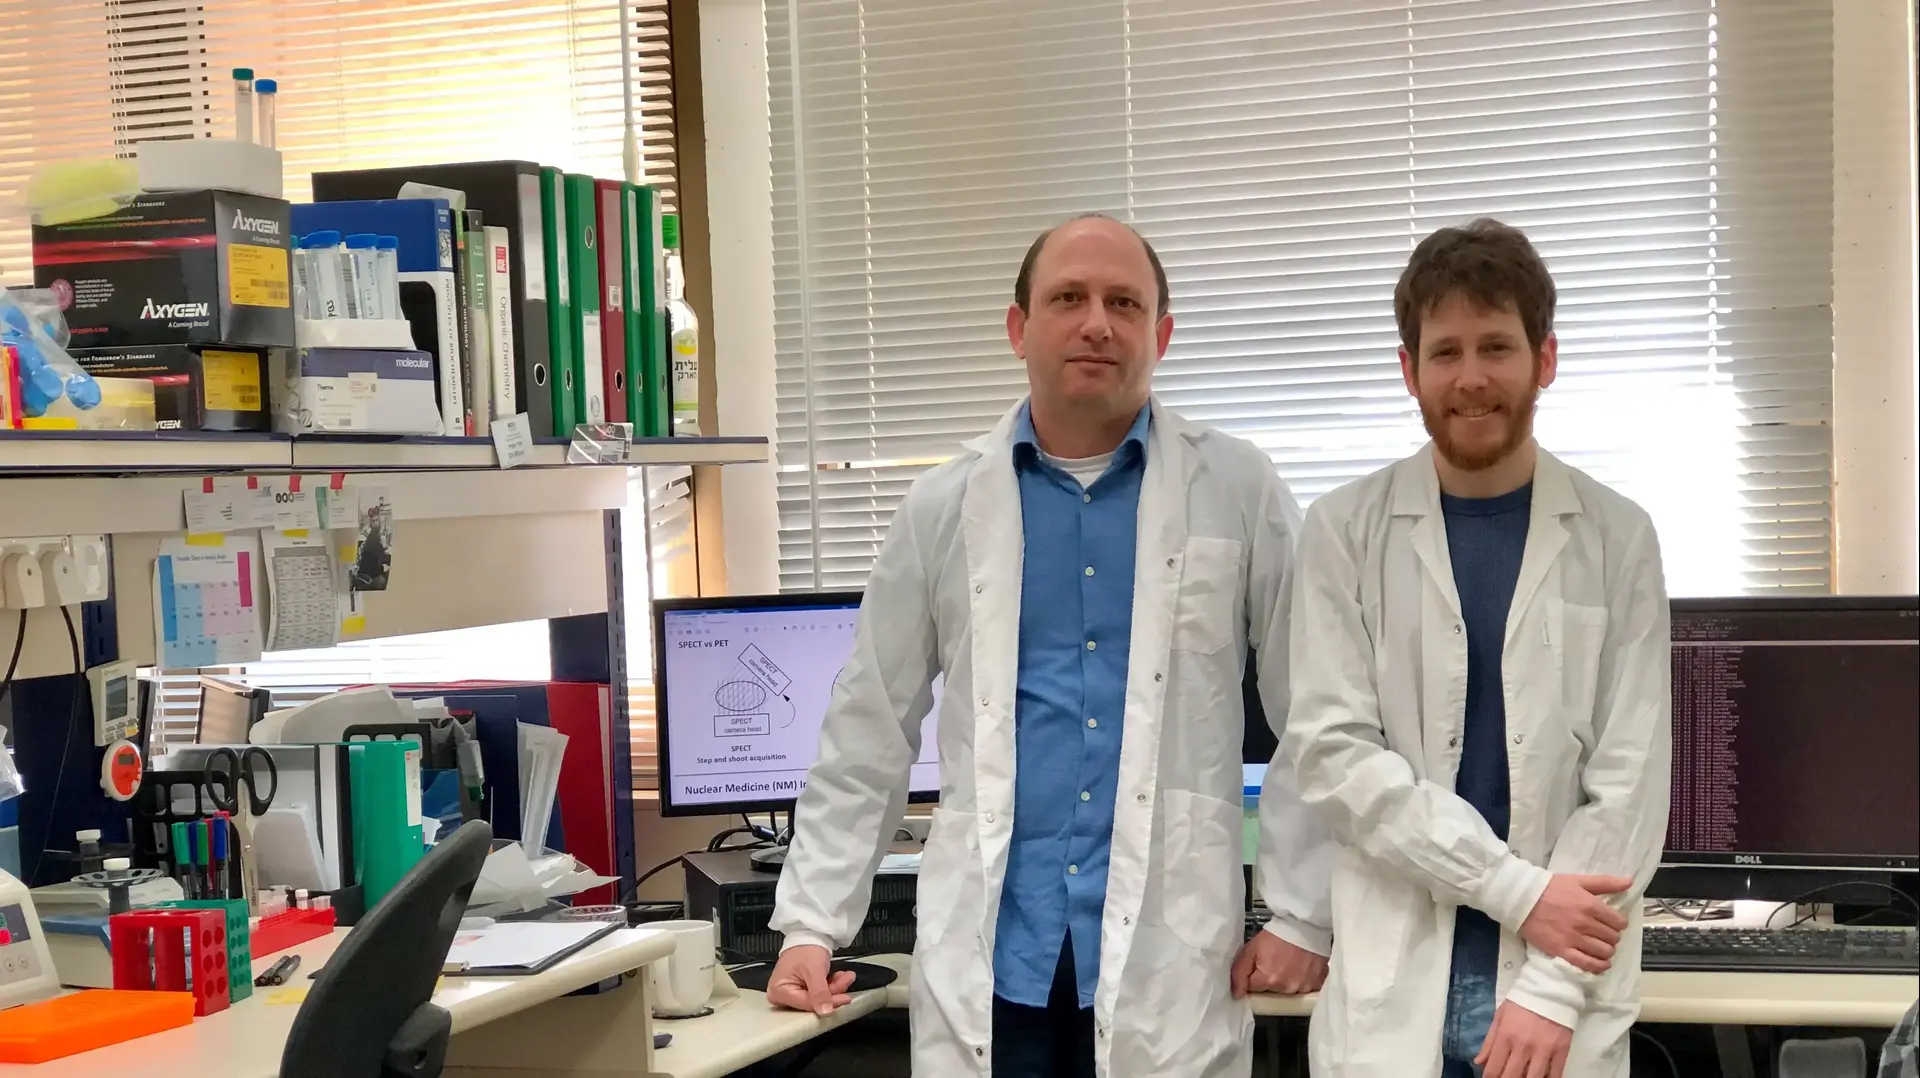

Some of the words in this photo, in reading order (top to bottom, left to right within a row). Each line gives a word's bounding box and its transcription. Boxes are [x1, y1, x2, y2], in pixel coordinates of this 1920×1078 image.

[232, 208, 280, 235] AXYGEN
[140, 298, 209, 320] AXYGEN
[499, 296, 507, 337] Organic
[503, 341, 511, 399] Chemistry
[395, 357, 430, 368] molecular
[449, 342, 457, 405] BIOCHEMISTRY
[155, 419, 182, 429] YGEN
[678, 640, 702, 649] SPECT
[714, 639, 729, 648] PET
[759, 656, 778, 674] SPECT
[748, 658, 766, 676] camera
[765, 673, 779, 687] head
[731, 717, 752, 726] SPECT
[724, 726, 746, 734] camera
[747, 725, 762, 733] head
[731, 744, 752, 752] SPECT
[697, 756, 711, 765] Step
[711, 756, 727, 764] and
[728, 755, 748, 763] shoot
[749, 753, 787, 764] acquisition
[685, 785, 723, 795] Nuclear
[725, 782, 770, 793] Medicine
[772, 780, 798, 792] (NM)
[1735, 855, 1762, 864] DELL
